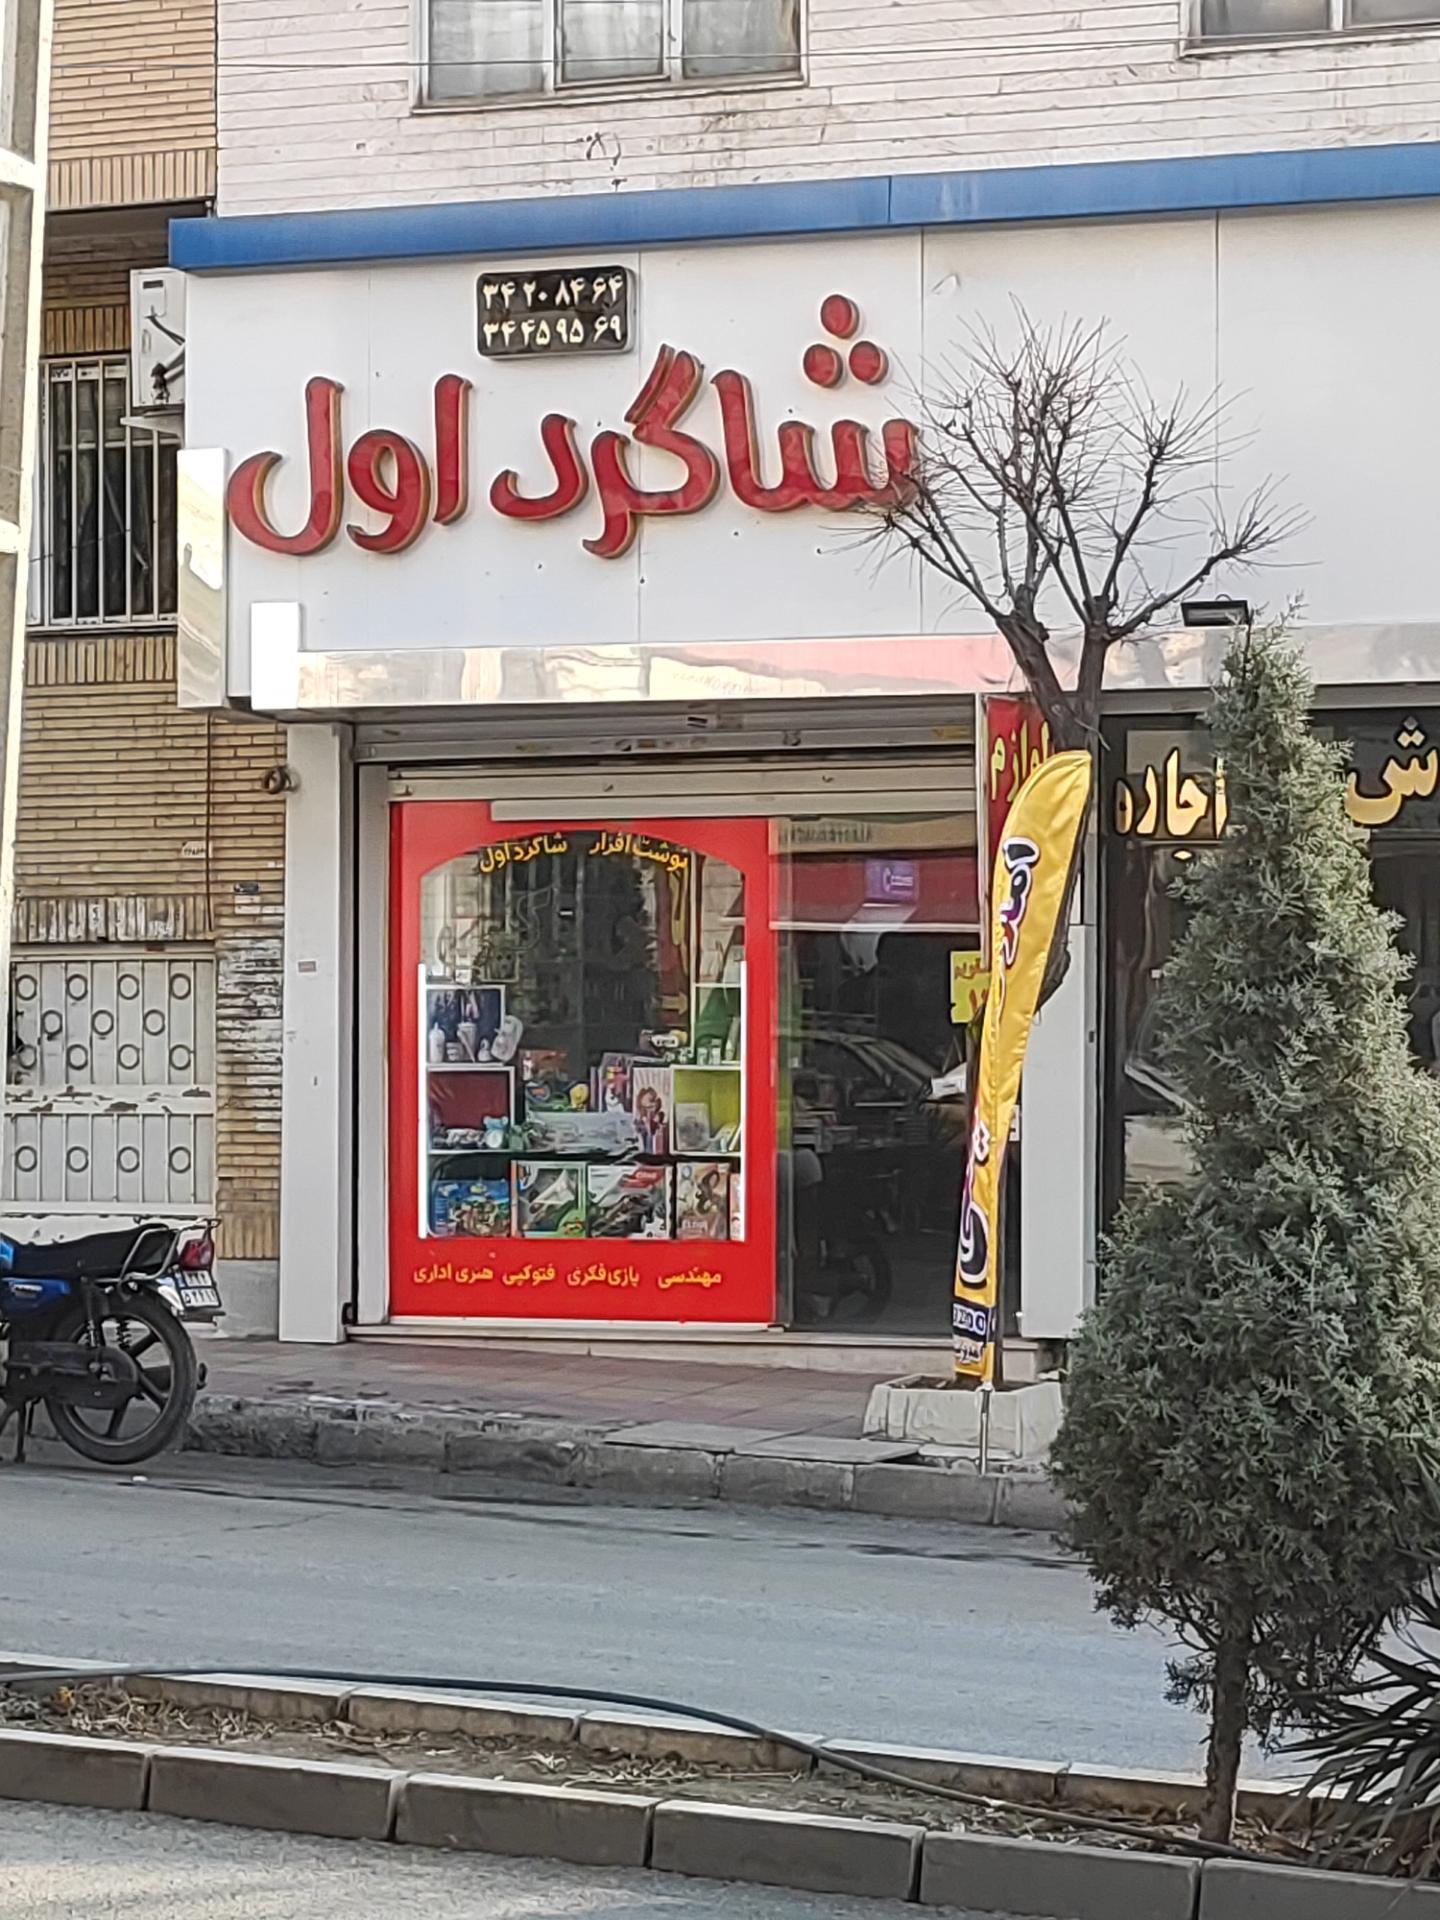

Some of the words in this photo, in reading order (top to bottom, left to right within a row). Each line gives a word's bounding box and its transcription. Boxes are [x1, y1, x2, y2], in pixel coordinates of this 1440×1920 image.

[490, 293, 920, 559] شاگرد
[228, 374, 475, 557] اول
[589, 831, 632, 855] افزار
[632, 835, 689, 871] نوشت
[479, 842, 511, 873] اول
[413, 1262, 452, 1284] اداری
[502, 1262, 556, 1287] فتوکپی
[607, 1264, 640, 1288] بازی
[657, 1266, 722, 1289] مهندسی
